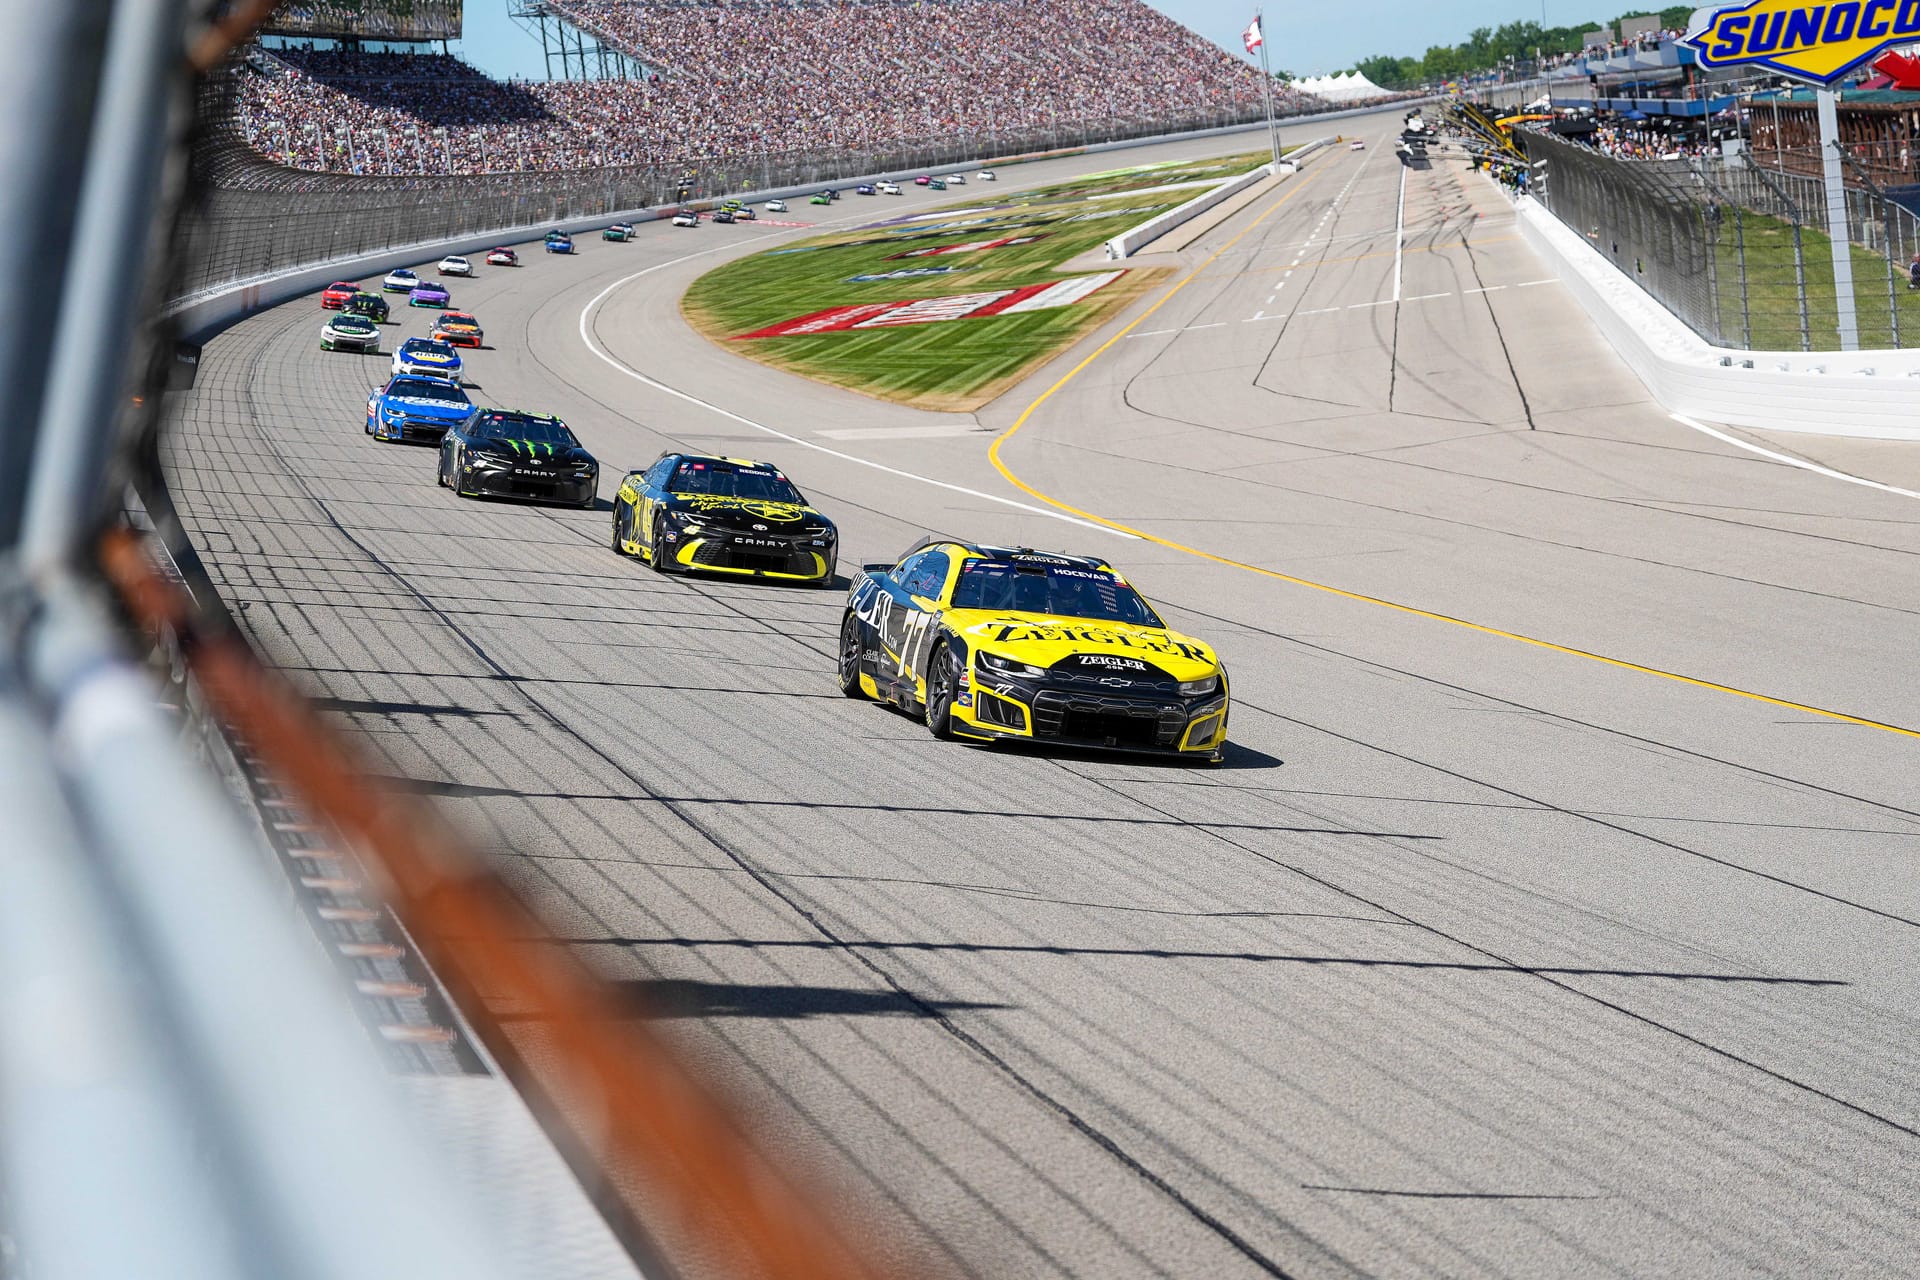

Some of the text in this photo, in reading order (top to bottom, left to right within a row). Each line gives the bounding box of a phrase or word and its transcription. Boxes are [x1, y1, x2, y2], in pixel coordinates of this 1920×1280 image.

[1711, 0, 1920, 57] SUNOCO
[515, 468, 557, 478] CAMRY
[734, 537, 788, 548] CAMRY
[1017, 554, 1071, 566] ZEIGLER
[1053, 568, 1110, 581] HOCEVAR
[898, 608, 932, 681] 77
[987, 624, 1217, 667] ZEIGLER
[1079, 656, 1147, 671] ZEIGLER
[993, 683, 1014, 696] 77
